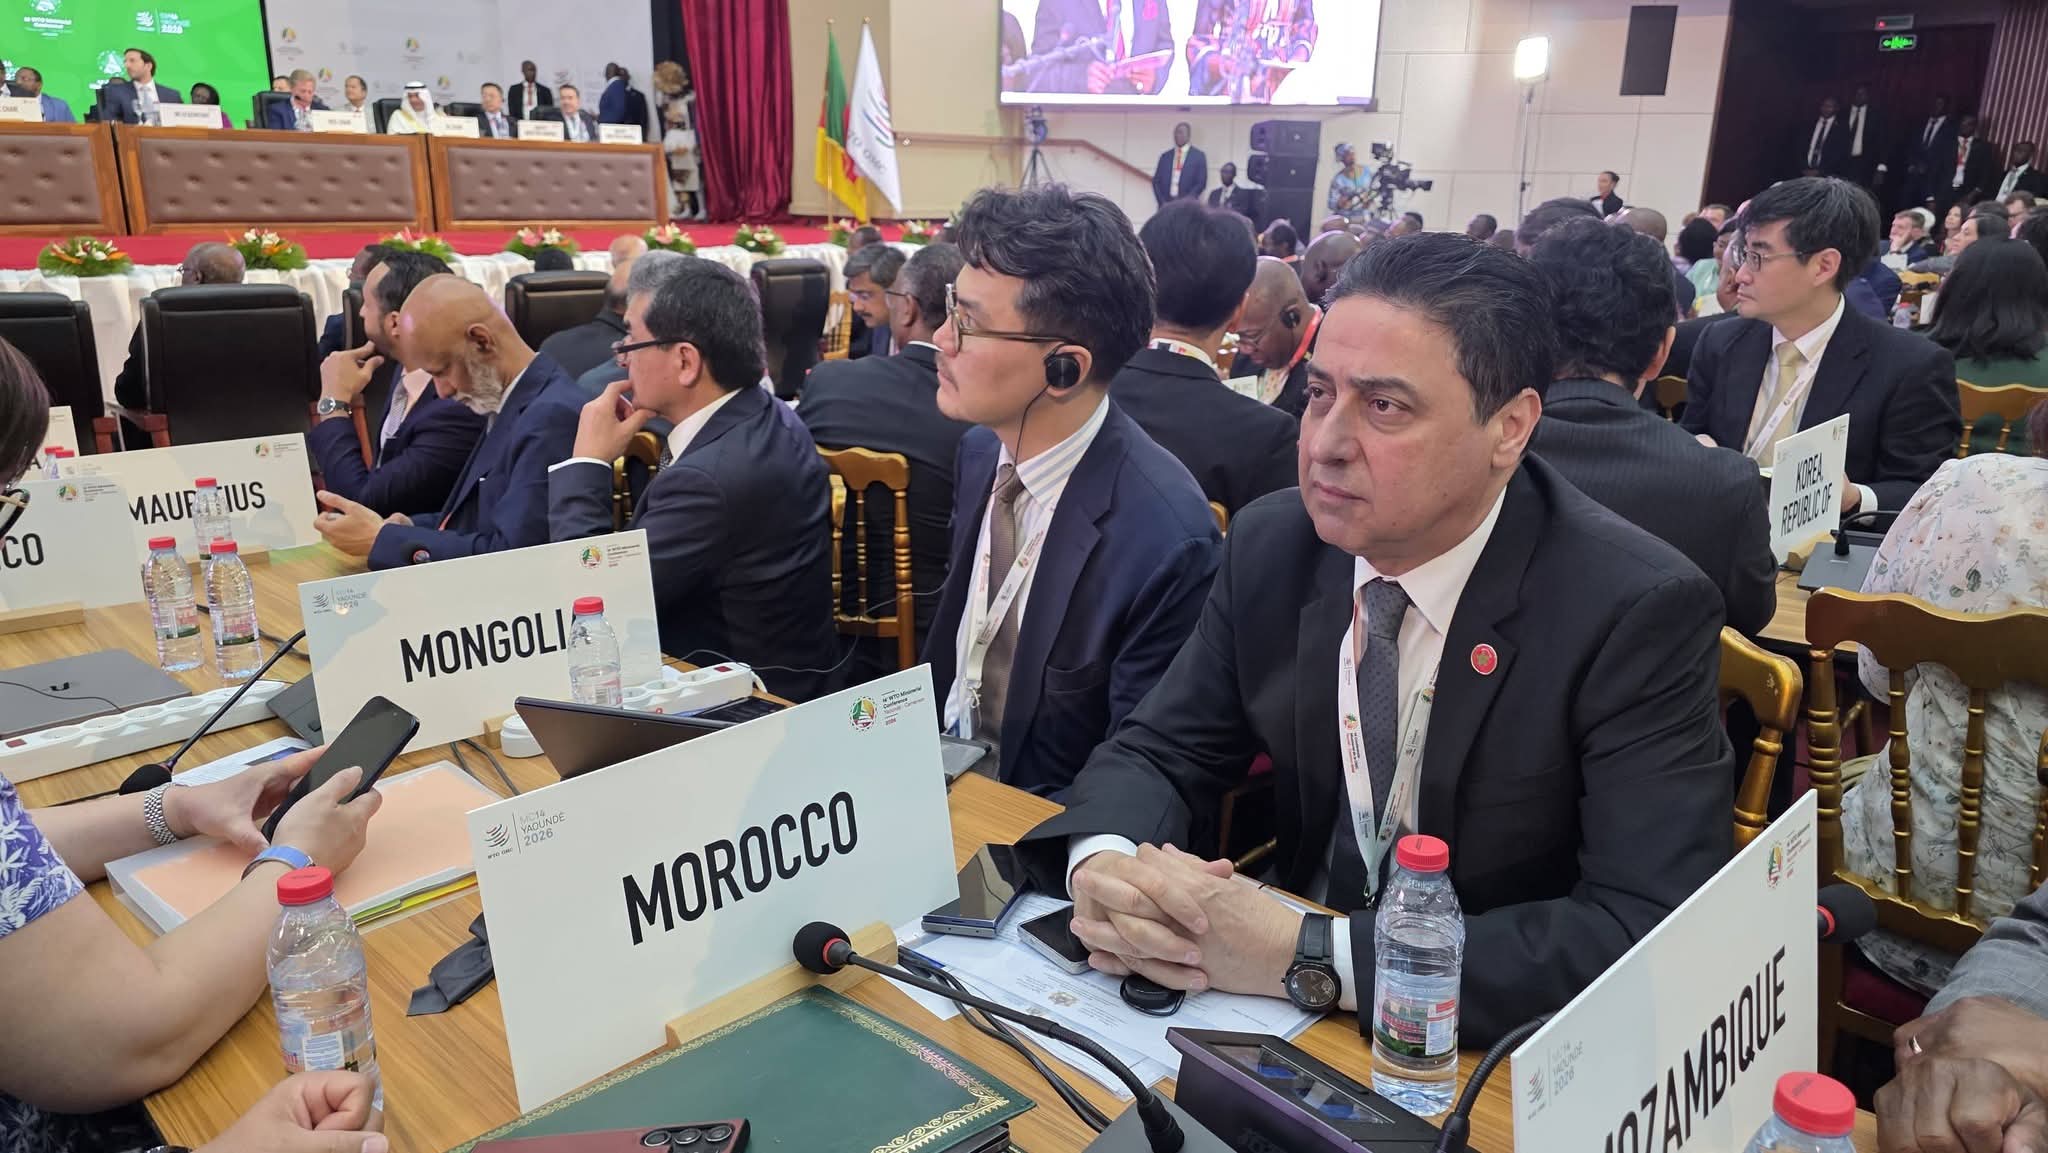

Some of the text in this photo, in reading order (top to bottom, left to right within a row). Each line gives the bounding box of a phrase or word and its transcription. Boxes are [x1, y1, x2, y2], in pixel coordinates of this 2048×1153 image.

[1795, 452, 1824, 494] KOREA,
[128, 481, 266, 525] MAURIUS
[1780, 482, 1833, 537] REPUBLIC OF
[400, 608, 578, 683] MONGOLI
[524, 828, 554, 846] 2026
[622, 791, 858, 946] MOROCCO
